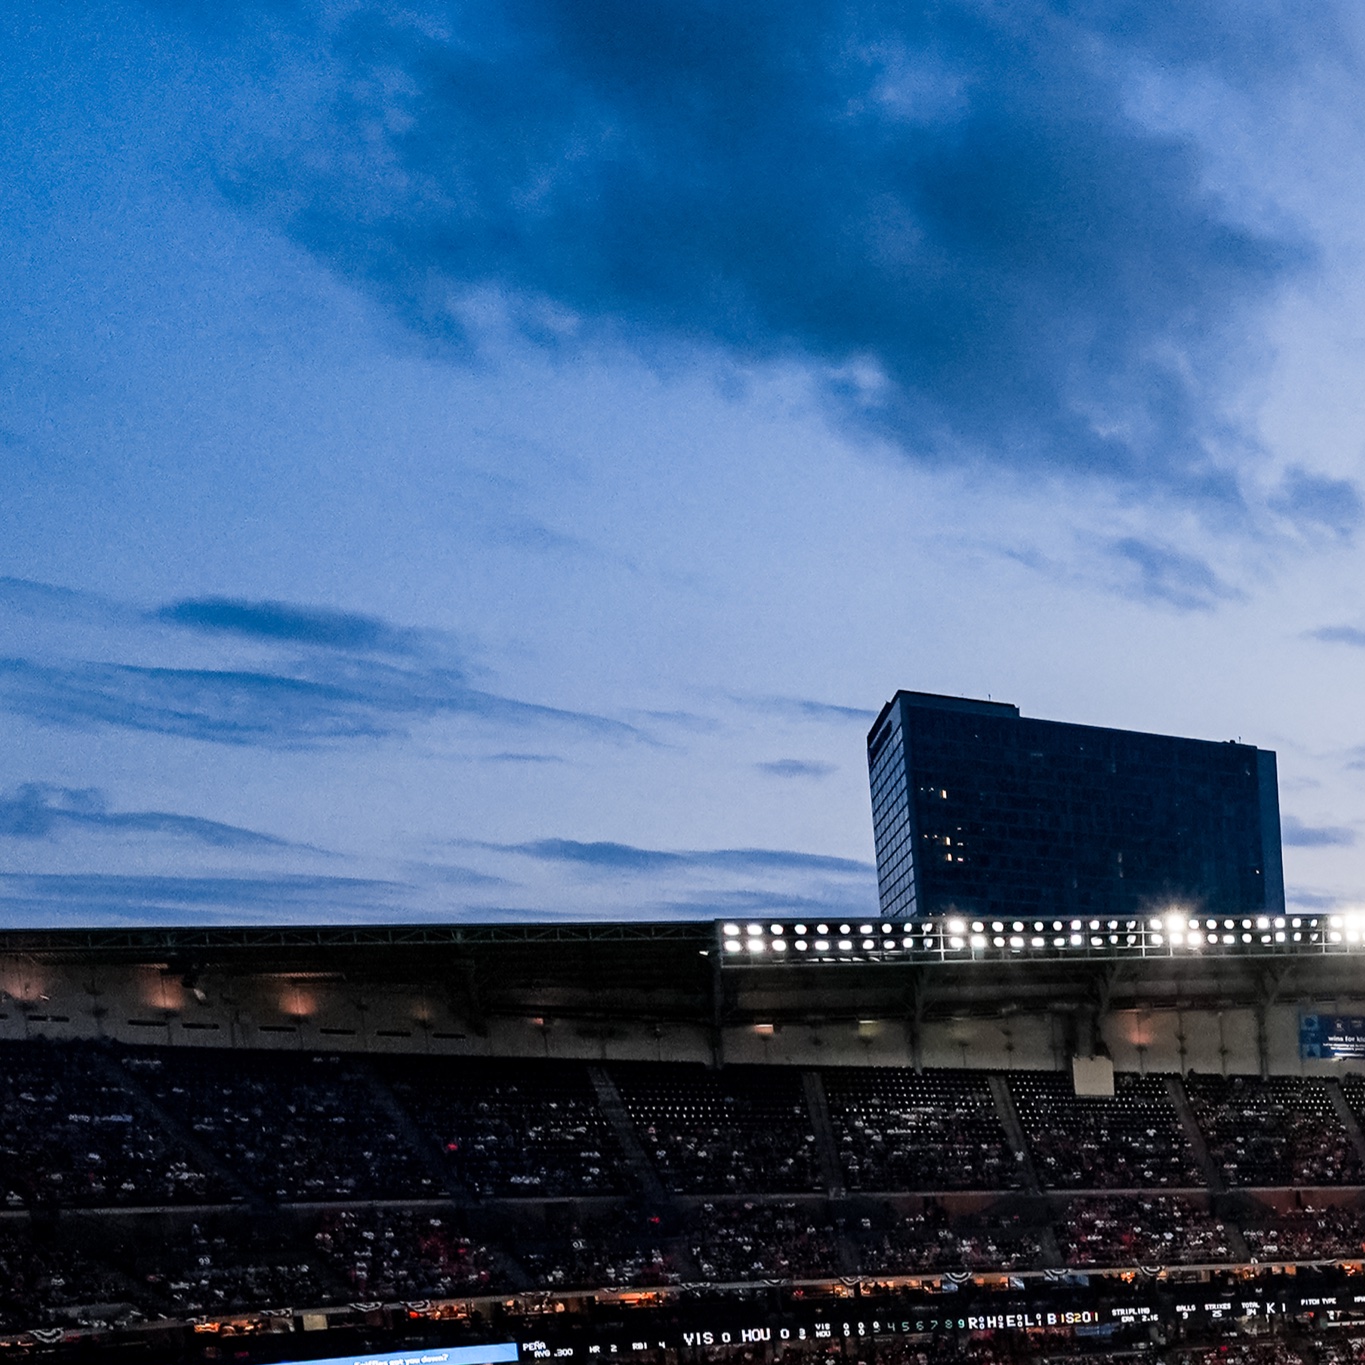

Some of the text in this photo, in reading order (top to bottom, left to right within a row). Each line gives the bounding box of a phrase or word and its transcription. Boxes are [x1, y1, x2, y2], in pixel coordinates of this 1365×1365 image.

[1266, 1302, 1275, 1314] K
[887, 1322, 896, 1332] 4
[902, 1322, 909, 1332] 5
[916, 1321, 924, 1331] 6
[930, 1321, 938, 1330] 7
[958, 1319, 965, 1329] 9
[683, 1332, 714, 1346] VIS
[741, 1328, 771, 1342] HOU
[523, 1341, 546, 1351] PEÑA
[610, 1344, 618, 1353] 2
